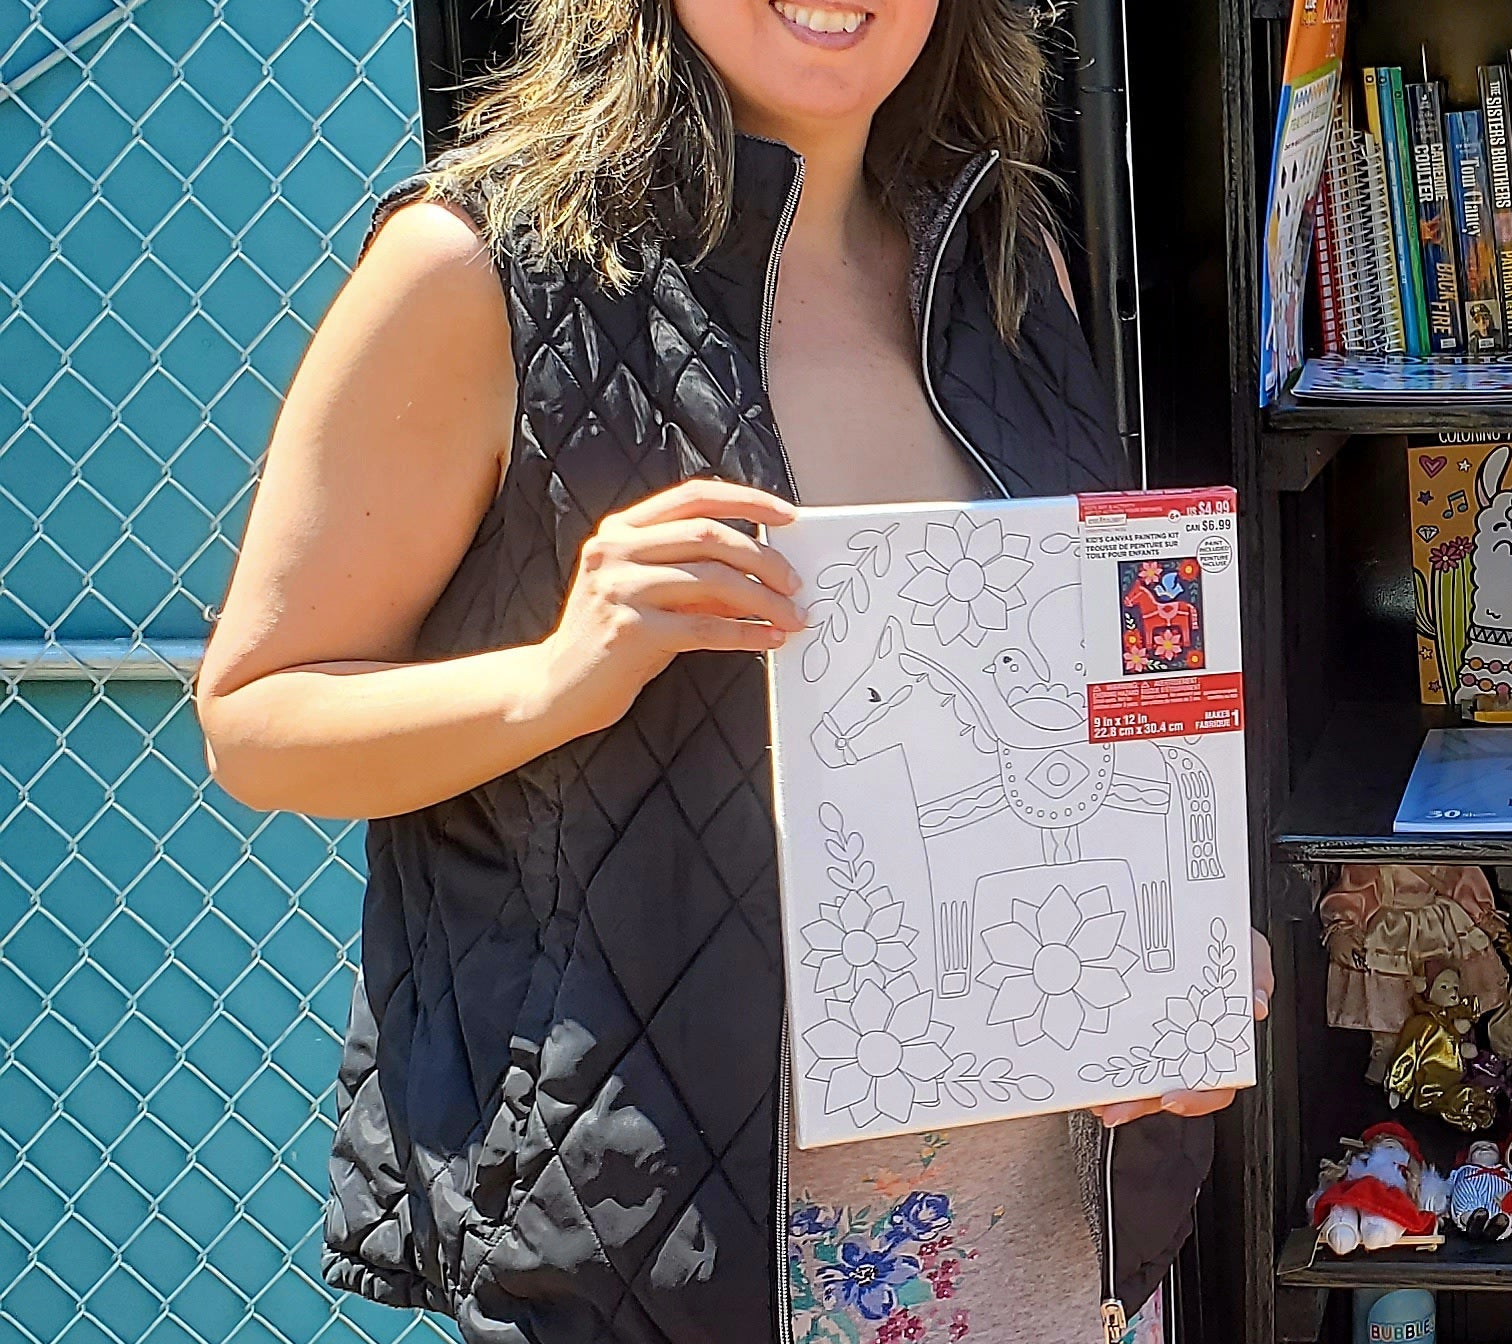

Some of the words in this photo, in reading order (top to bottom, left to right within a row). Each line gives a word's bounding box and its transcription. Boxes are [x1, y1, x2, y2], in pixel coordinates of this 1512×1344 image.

[1490, 81, 1501, 95] THE
[1486, 96, 1506, 145] SISTERS
[1414, 144, 1434, 203] COULTER
[1430, 143, 1448, 200] CATHERINE
[1460, 157, 1480, 189] Tom
[1490, 145, 1511, 208] BROTHERS
[1462, 192, 1483, 237] Clancy
[1431, 301, 1451, 335] FIRE
[1199, 500, 1230, 516] $4.99
[1185, 523, 1200, 532] CAN
[1202, 518, 1231, 532] $6.99
[1094, 718, 1101, 727] 9
[1103, 717, 1113, 727] in
[1123, 715, 1136, 726] 12
[1137, 714, 1148, 724] in
[1119, 726, 1134, 736] cm
[1144, 722, 1166, 734] 30.4
[1168, 722, 1184, 731] cm
[1231, 709, 1239, 726] 1
